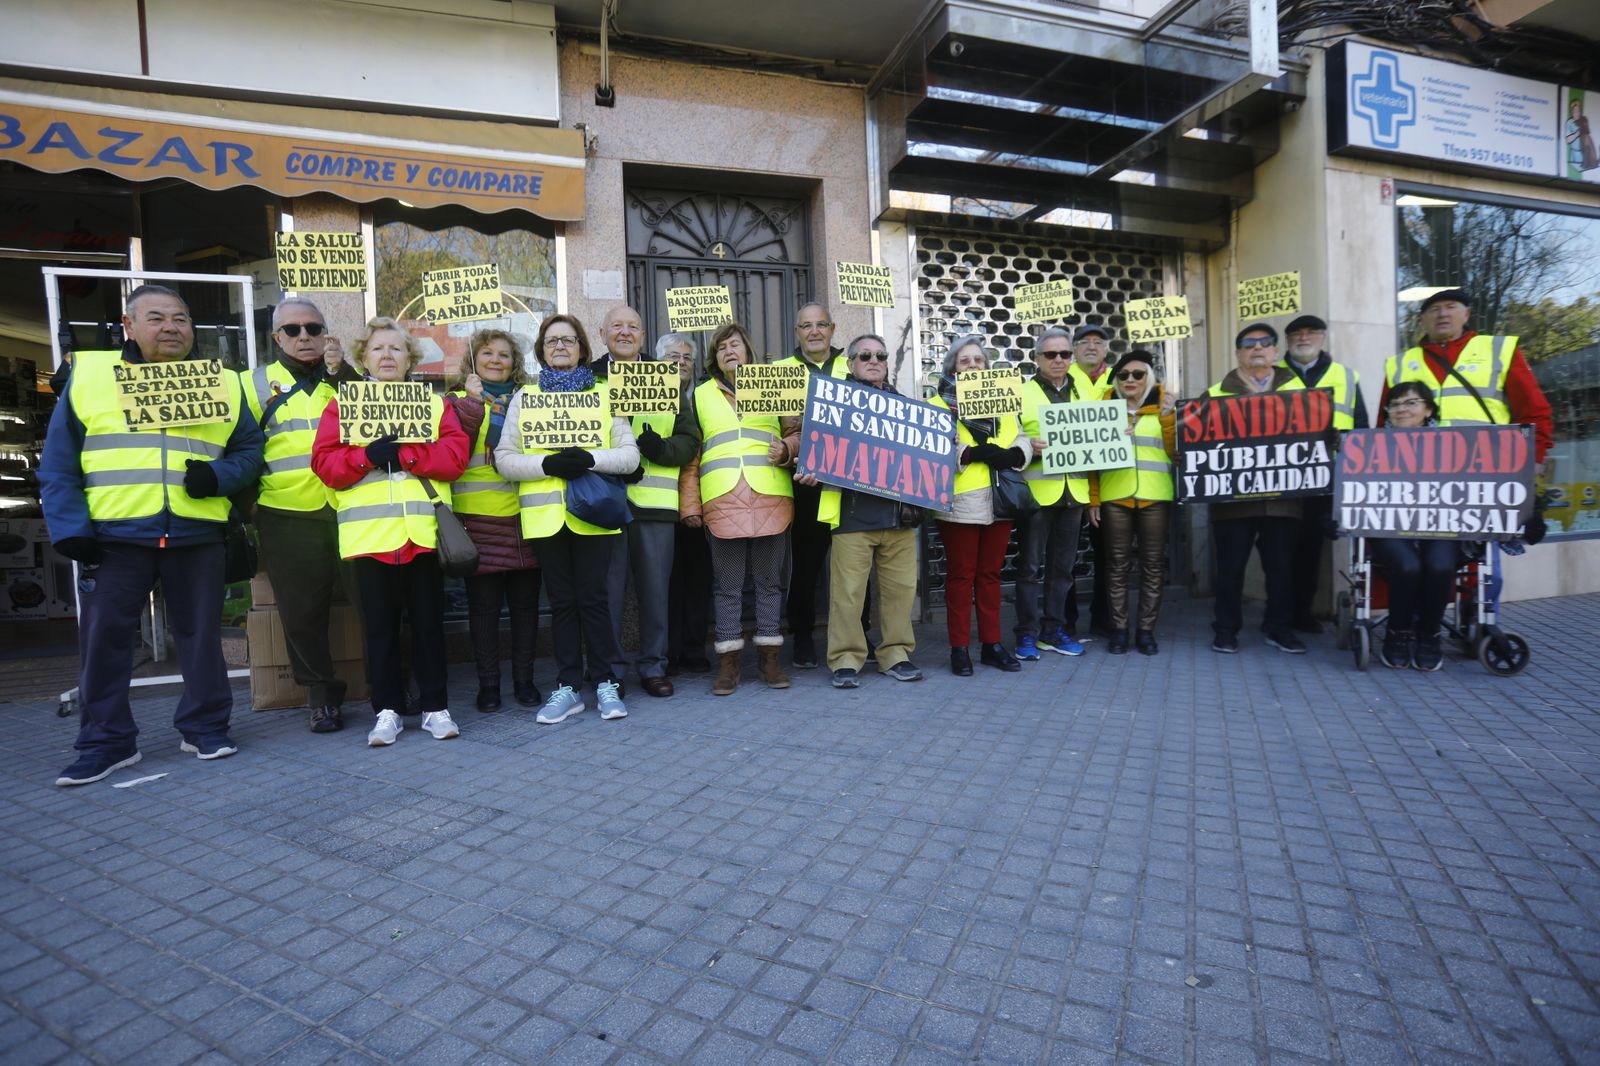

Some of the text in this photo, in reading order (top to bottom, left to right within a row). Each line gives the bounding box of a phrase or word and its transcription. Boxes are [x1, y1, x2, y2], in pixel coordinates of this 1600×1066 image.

[0, 114, 261, 179] BAZAR
[1442, 143, 1468, 158] Tfno
[1471, 148, 1490, 161] 957
[285, 152, 543, 195] COMPRE Y COMPARE
[277, 234, 363, 247] LA SALUD
[277, 249, 364, 264] NO SE VENDE
[712, 242, 726, 258] 4
[279, 268, 366, 288] SE DEFIENDE
[422, 266, 497, 282] CUBRIR TODAS
[837, 262, 890, 278] SANIDAD
[424, 276, 498, 297] LAS BAJAS
[1022, 282, 1062, 296] FUERA
[1238, 280, 1298, 296] SANIDAD
[1245, 274, 1290, 288] POR UNA
[454, 294, 470, 304] EN
[673, 288, 720, 296] RESCATAN
[840, 284, 894, 304] PREVENTIVA
[1016, 290, 1071, 304] ESPECULADORES
[668, 295, 729, 308] BANQUEROS
[1145, 298, 1166, 308] NOS
[1240, 298, 1298, 318] DIGNA
[426, 302, 502, 322] SANIDAD
[678, 307, 722, 316] DESPIDEN
[1016, 304, 1072, 320] SANIDAD
[1128, 306, 1186, 322] ROBAN
[670, 314, 732, 328] ENFERMERAS
[1130, 325, 1190, 340] SALUD
[114, 360, 220, 382] EL TRABAJO
[610, 363, 678, 374] UNIDOS
[736, 366, 805, 378] MAS RECURSOS
[956, 369, 1020, 382] LAS LISTAS
[121, 376, 220, 394] ESTABLE
[623, 376, 665, 386] POR LA
[736, 379, 806, 390] SANITARIOS
[982, 380, 996, 388] DE
[134, 391, 214, 407] MEJORA
[340, 383, 431, 402] NO AL CIERRE
[609, 388, 678, 400] SANIDAD
[760, 390, 782, 398] SON
[964, 388, 1015, 400] ESPERA
[521, 394, 600, 409] RESCATEMOS
[610, 400, 678, 412] PÚBLICA
[736, 399, 804, 412] NECESARIOS
[814, 378, 952, 432] RECORTES
[959, 398, 1022, 416] DESESPERAN
[123, 401, 230, 426] LA SALUD
[340, 404, 432, 420] DE SERVICIOS
[553, 410, 570, 420] LA
[1044, 406, 1119, 426] SANIDAD
[1183, 390, 1331, 443] SANIDAD
[340, 422, 432, 438] Y CAMAS
[522, 420, 602, 432] SANIDAD
[810, 401, 951, 456] EN SANIDAD
[523, 432, 602, 444] PÚBLICA
[1048, 426, 1120, 446] PÚBLICA
[1046, 447, 1128, 468] 100 X 100
[1184, 440, 1330, 474] PÚBLICA
[1342, 430, 1528, 474] SANIDAD
[806, 430, 950, 504] ¡MATAN!
[1184, 466, 1330, 498] Y DE CALIDAD
[1342, 481, 1527, 506] DERECHO
[1341, 506, 1526, 534] UNIVERSAL
